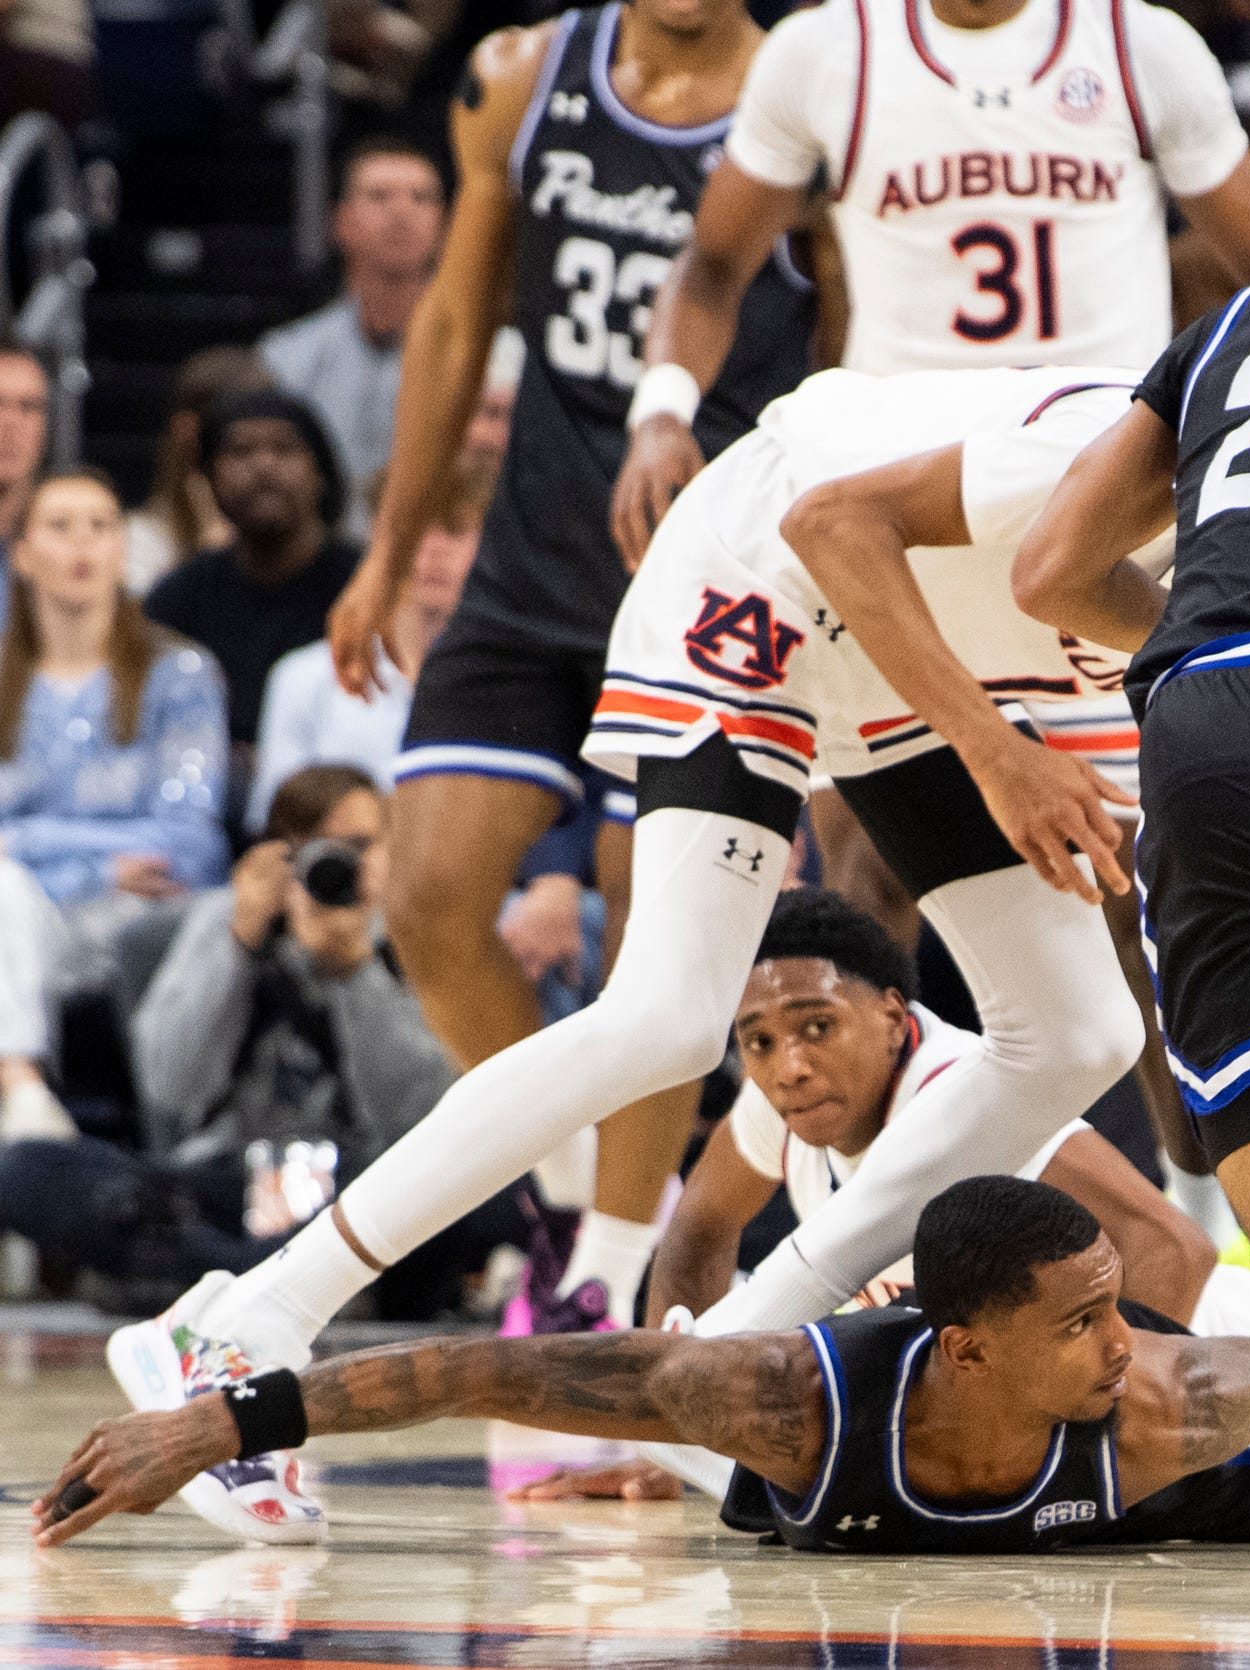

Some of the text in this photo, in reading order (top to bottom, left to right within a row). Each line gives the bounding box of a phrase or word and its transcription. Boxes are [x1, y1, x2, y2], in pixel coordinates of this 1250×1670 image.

[876, 152, 1122, 218] AUBURN
[545, 237, 675, 387] 33
[951, 218, 1058, 343] 31
